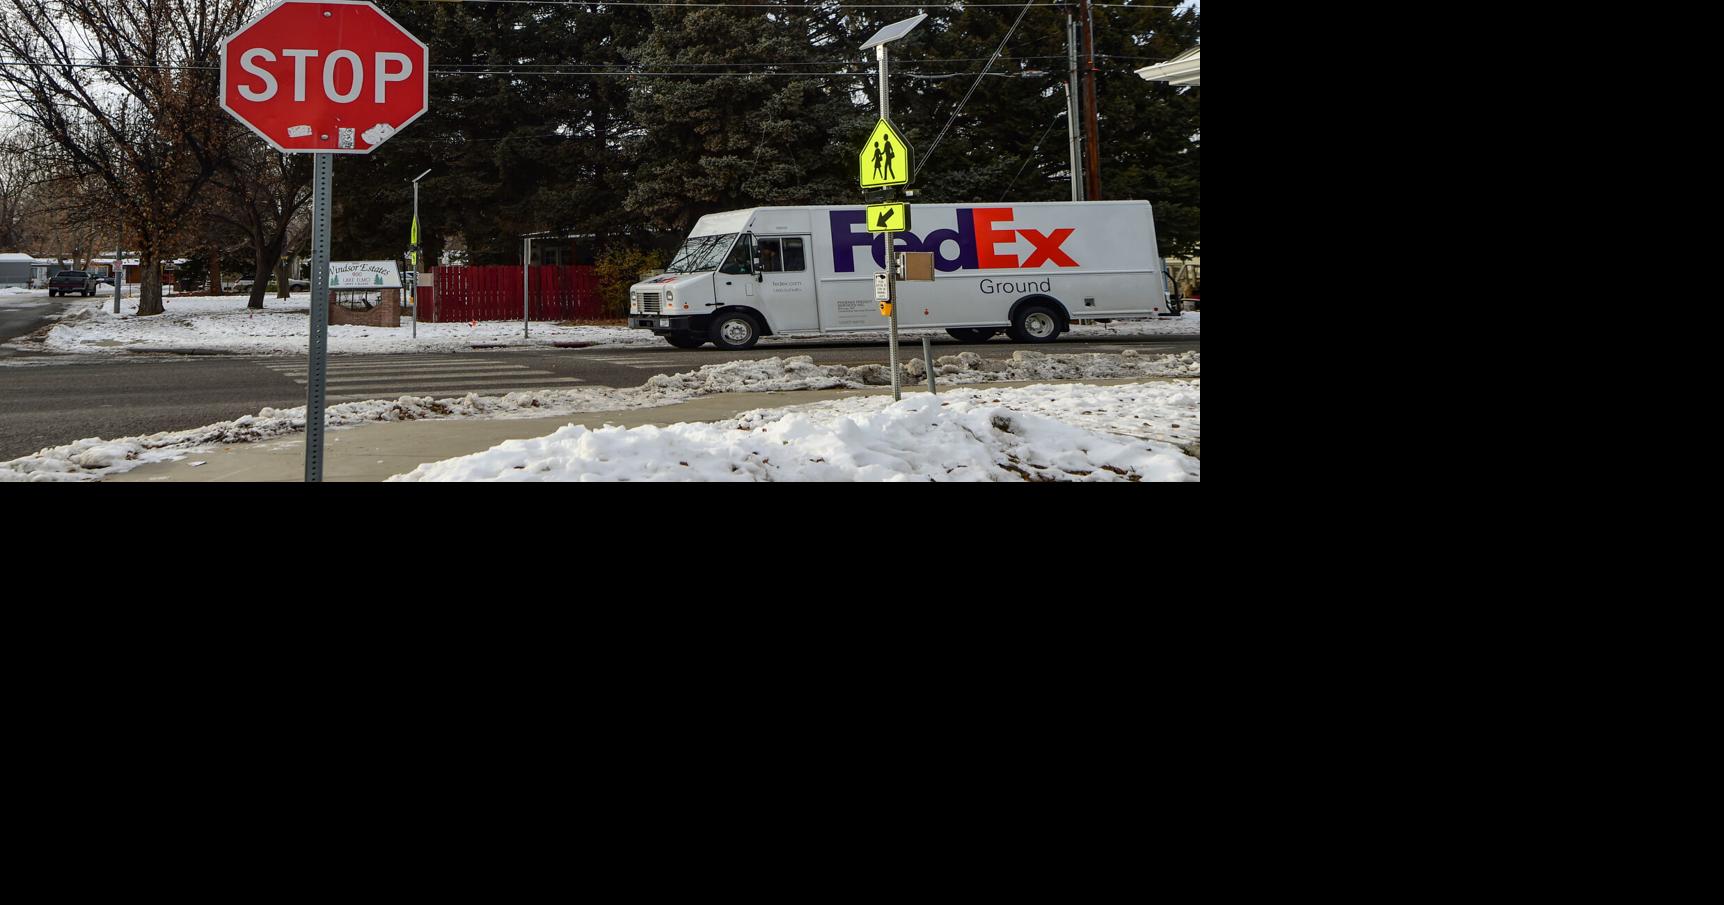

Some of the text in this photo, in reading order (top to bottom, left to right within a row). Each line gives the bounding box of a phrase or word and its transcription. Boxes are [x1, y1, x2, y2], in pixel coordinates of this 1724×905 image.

[237, 47, 413, 104] STOP
[829, 207, 1080, 273] FedEx
[360, 263, 390, 276] Estates
[979, 278, 1051, 295] Ground
